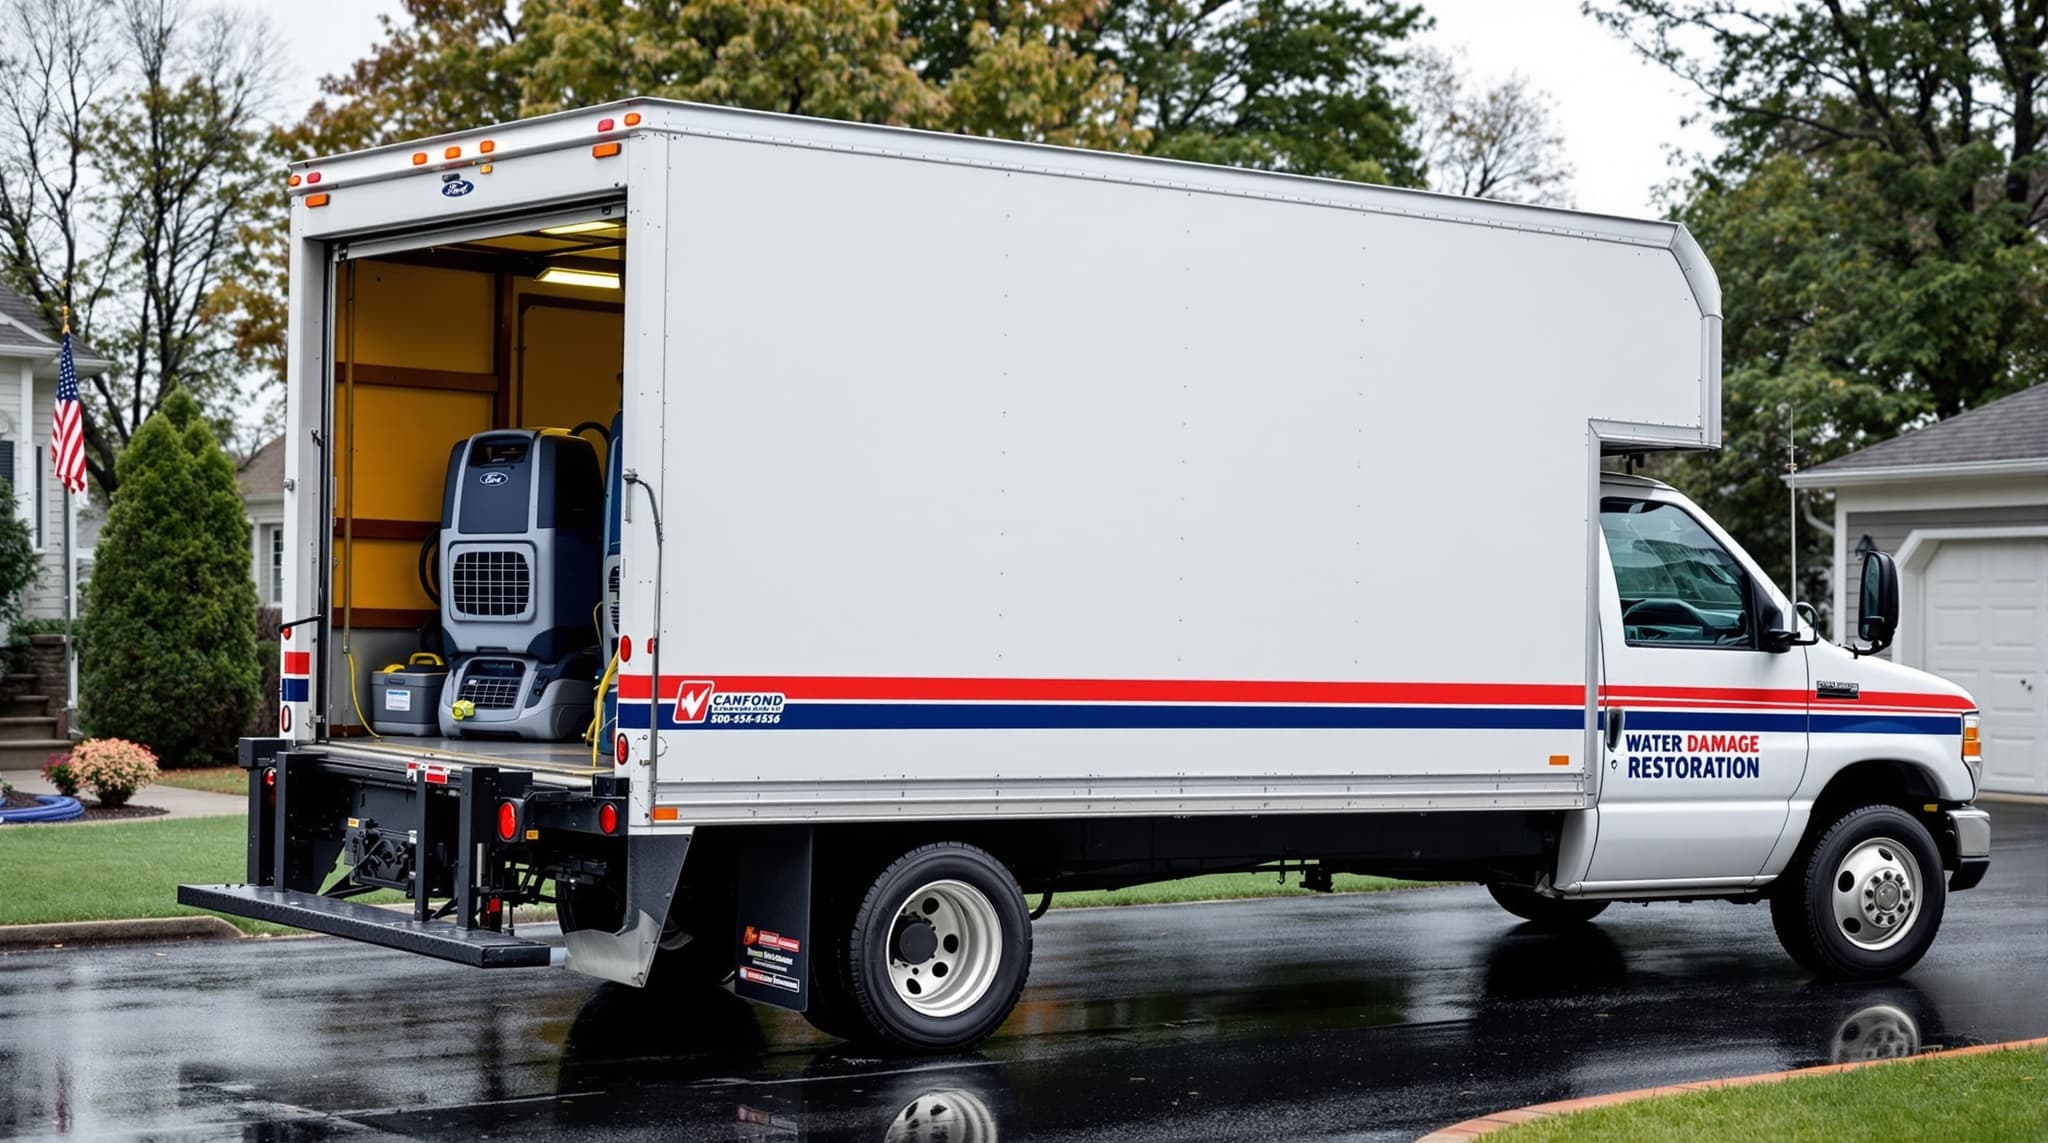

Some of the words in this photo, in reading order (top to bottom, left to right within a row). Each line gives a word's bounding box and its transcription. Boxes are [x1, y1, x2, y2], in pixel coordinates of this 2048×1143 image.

[713, 695, 783, 706] CANFOND
[1625, 734, 1682, 752] WATER
[1687, 735, 1759, 753] DAMAGE
[1628, 756, 1759, 778] RESTORATION
